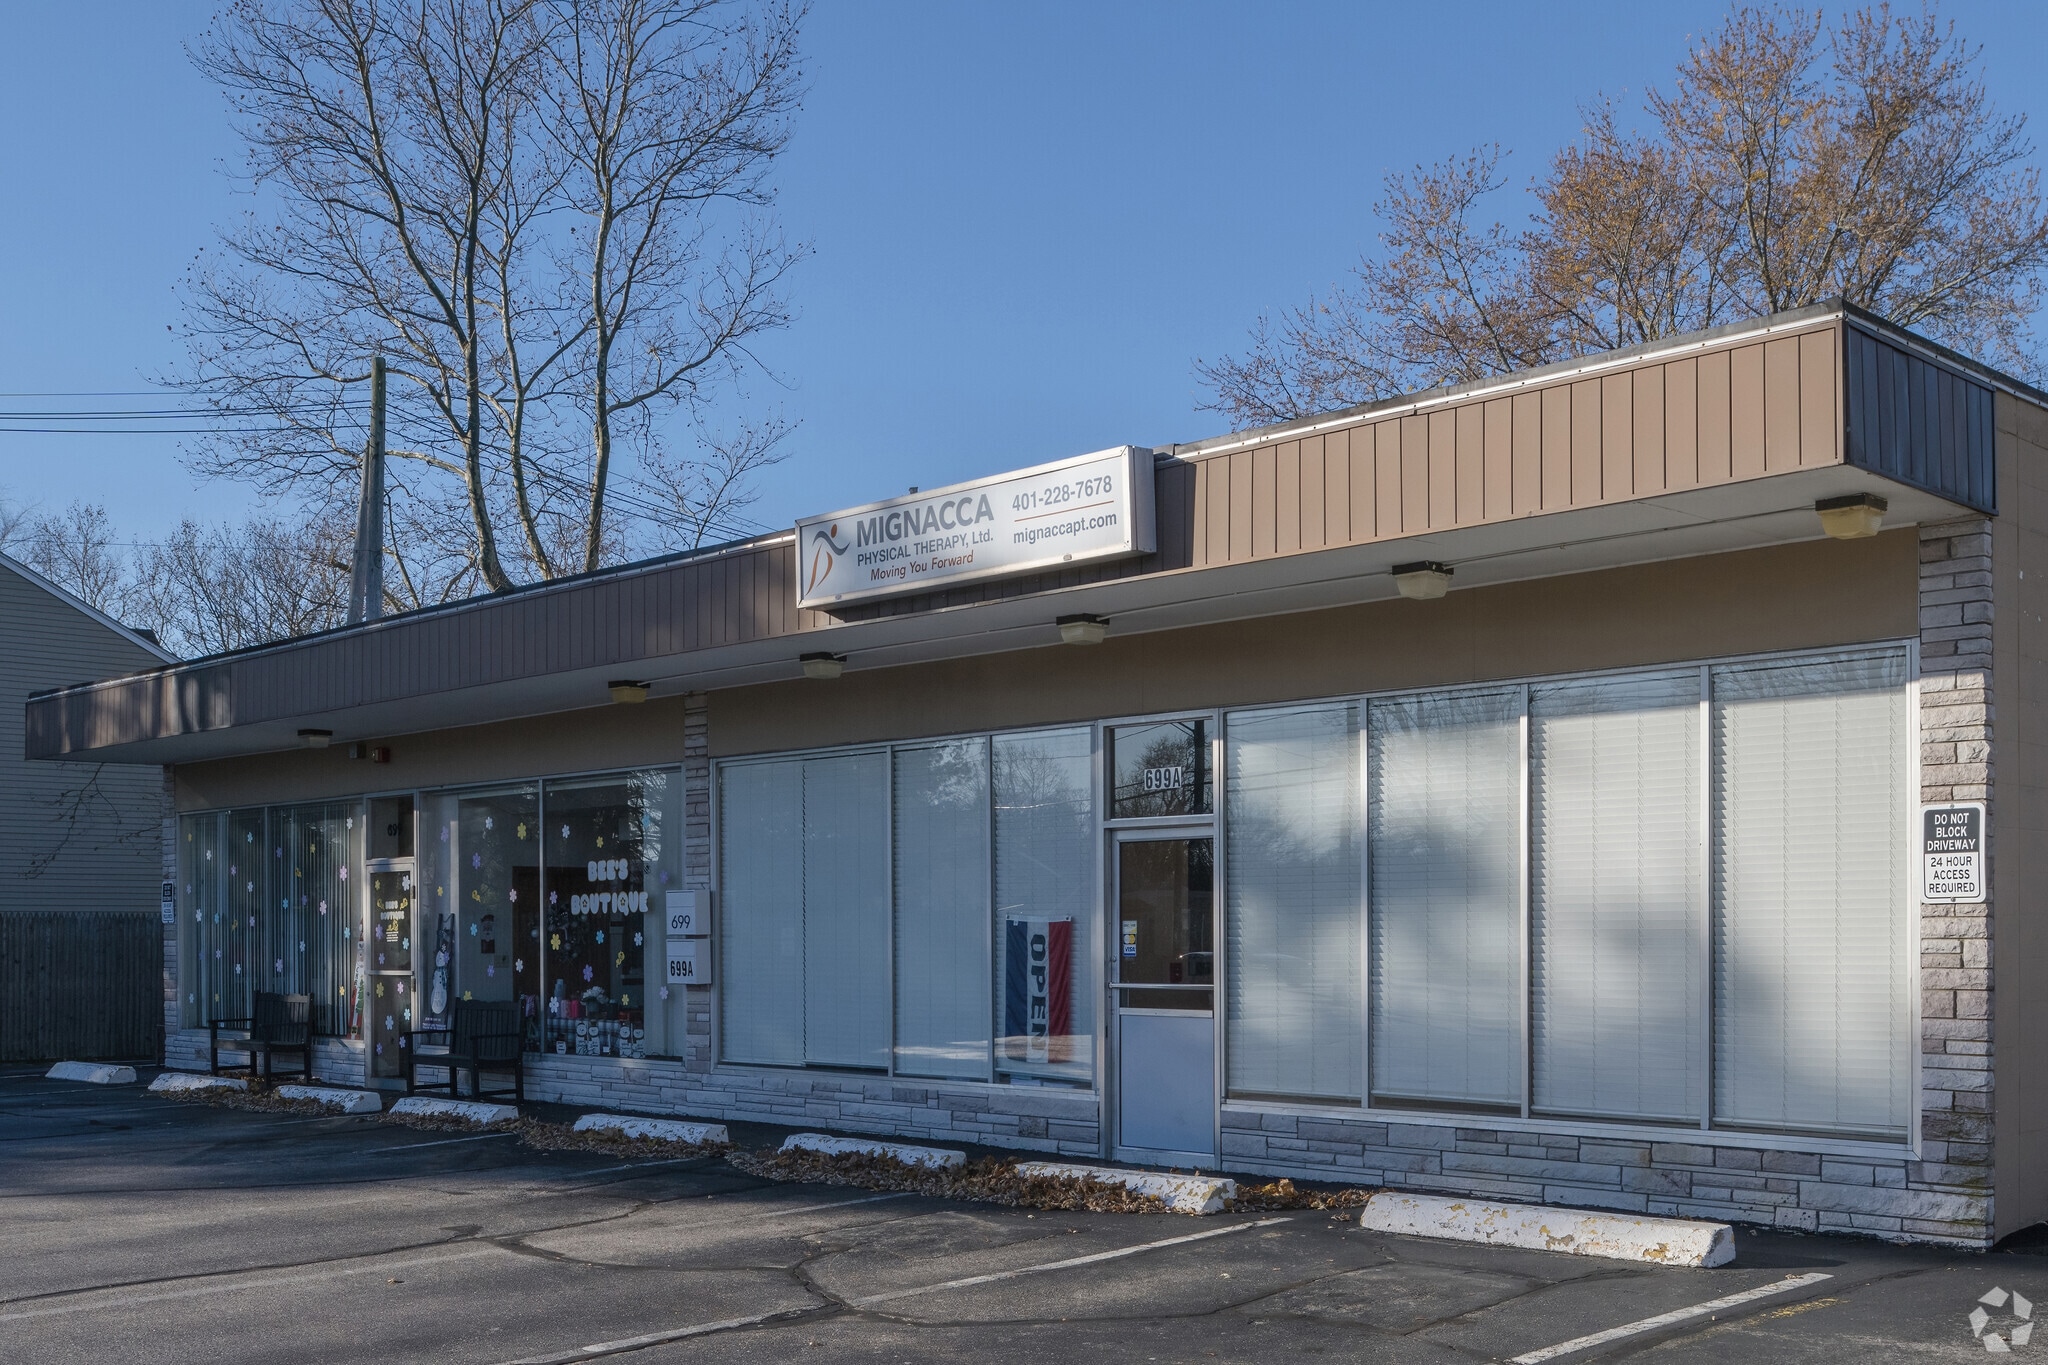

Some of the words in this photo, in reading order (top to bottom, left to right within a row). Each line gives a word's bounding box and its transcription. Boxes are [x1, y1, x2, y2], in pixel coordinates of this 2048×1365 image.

[1012, 475, 1113, 512] 401-228-7678
[856, 493, 994, 548] MIGNACCA
[1013, 513, 1117, 545] mignaccapt.com
[857, 547, 911, 567] PHYSICAL
[914, 533, 969, 556] THERAPY,
[972, 528, 994, 545] Ltd.
[870, 565, 906, 581] Moving
[909, 560, 928, 574] You
[931, 549, 974, 570] Forward
[1145, 767, 1181, 789] 699A
[1934, 814, 1947, 825] DO
[1950, 813, 1969, 824] NOT
[1936, 826, 1967, 838] BLOCK
[1927, 839, 1975, 851] DRIVEWAY
[587, 858, 629, 882] BEE'S
[1930, 857, 1943, 867] 24
[1946, 856, 1972, 867] HOUR
[1933, 869, 1970, 880] ACCESS
[1929, 882, 1975, 893] REQUIRED
[570, 891, 649, 916] BOUTIQUE
[671, 914, 691, 929] 699
[670, 960, 694, 977] 699A
[1030, 933, 1047, 1051] OPEN
